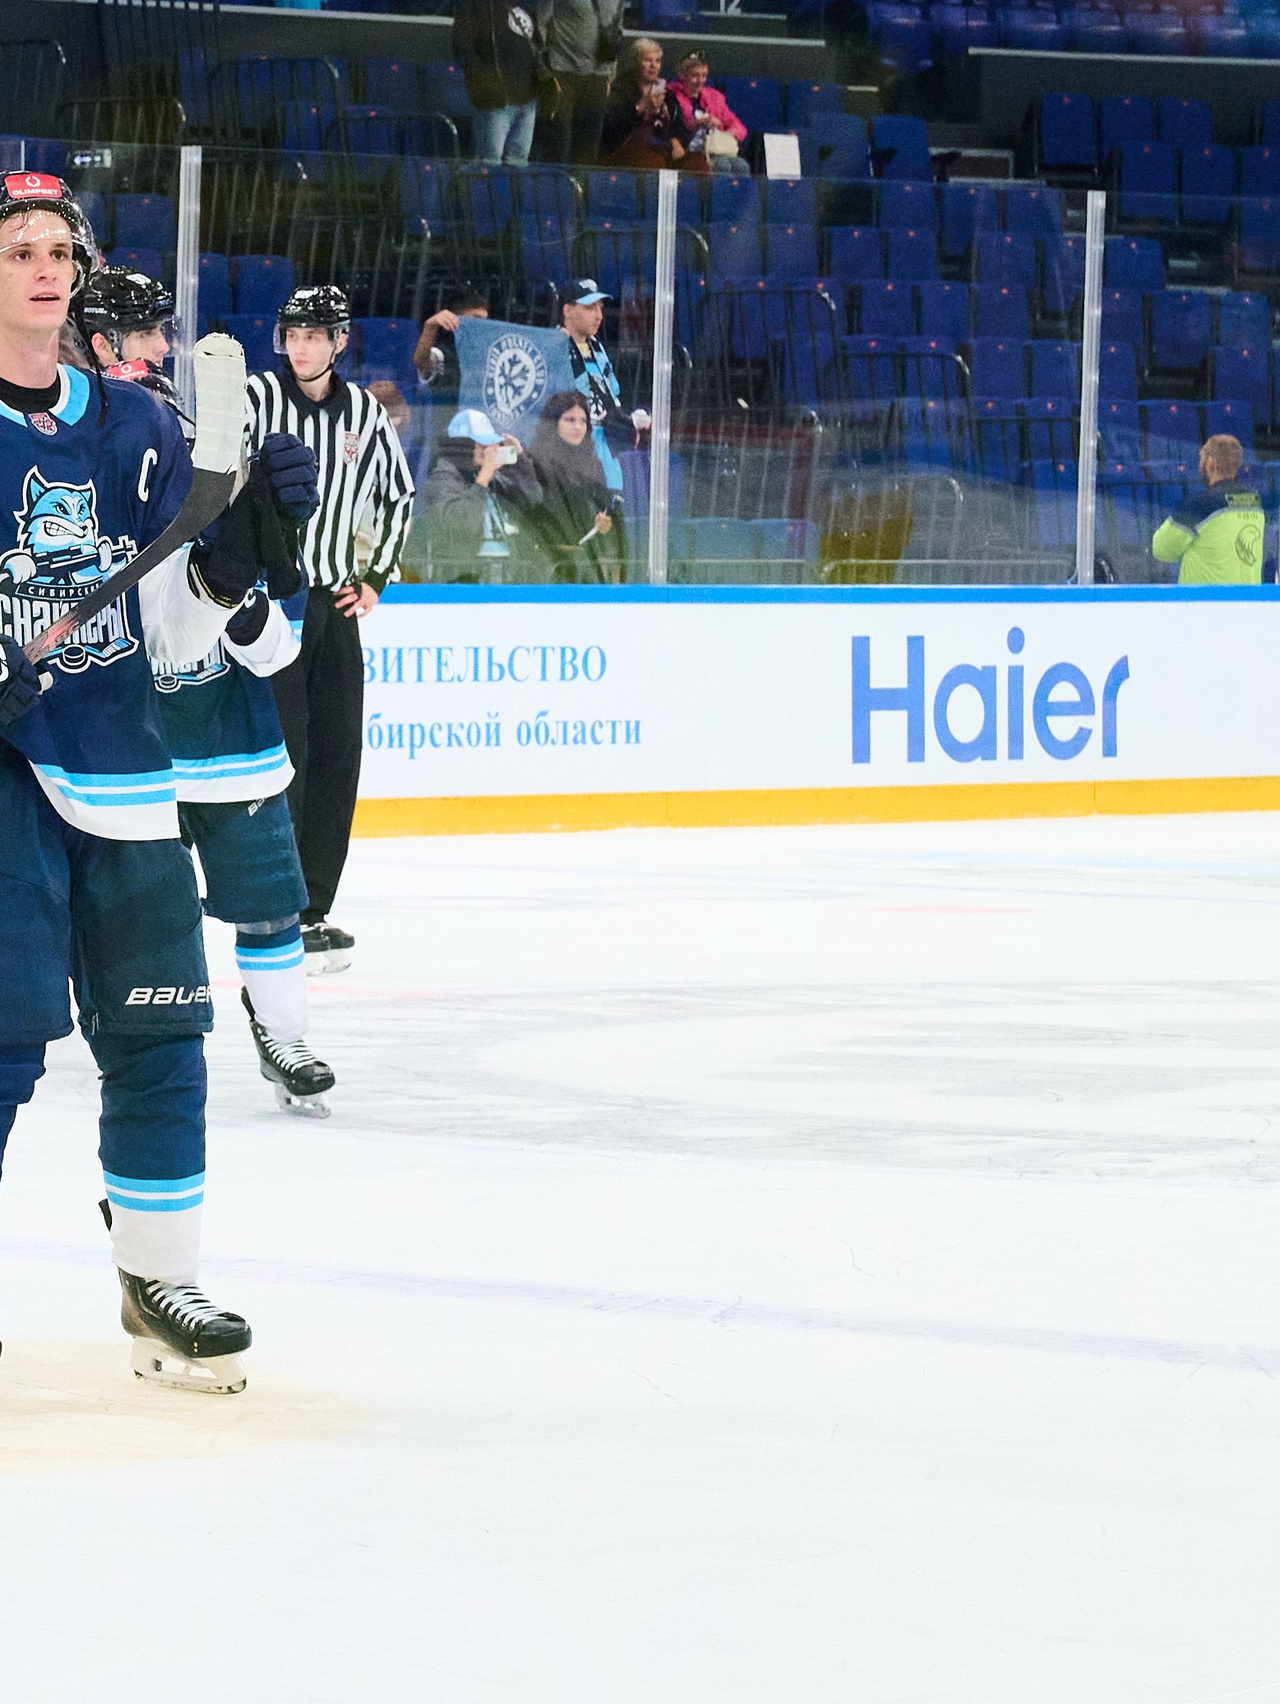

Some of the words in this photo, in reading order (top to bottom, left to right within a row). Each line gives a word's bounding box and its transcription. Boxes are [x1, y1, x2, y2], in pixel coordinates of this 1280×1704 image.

[12, 188, 58, 196] OLIMPBET
[851, 626, 1130, 764] Haier
[367, 711, 502, 759] бирской
[516, 710, 642, 747] области
